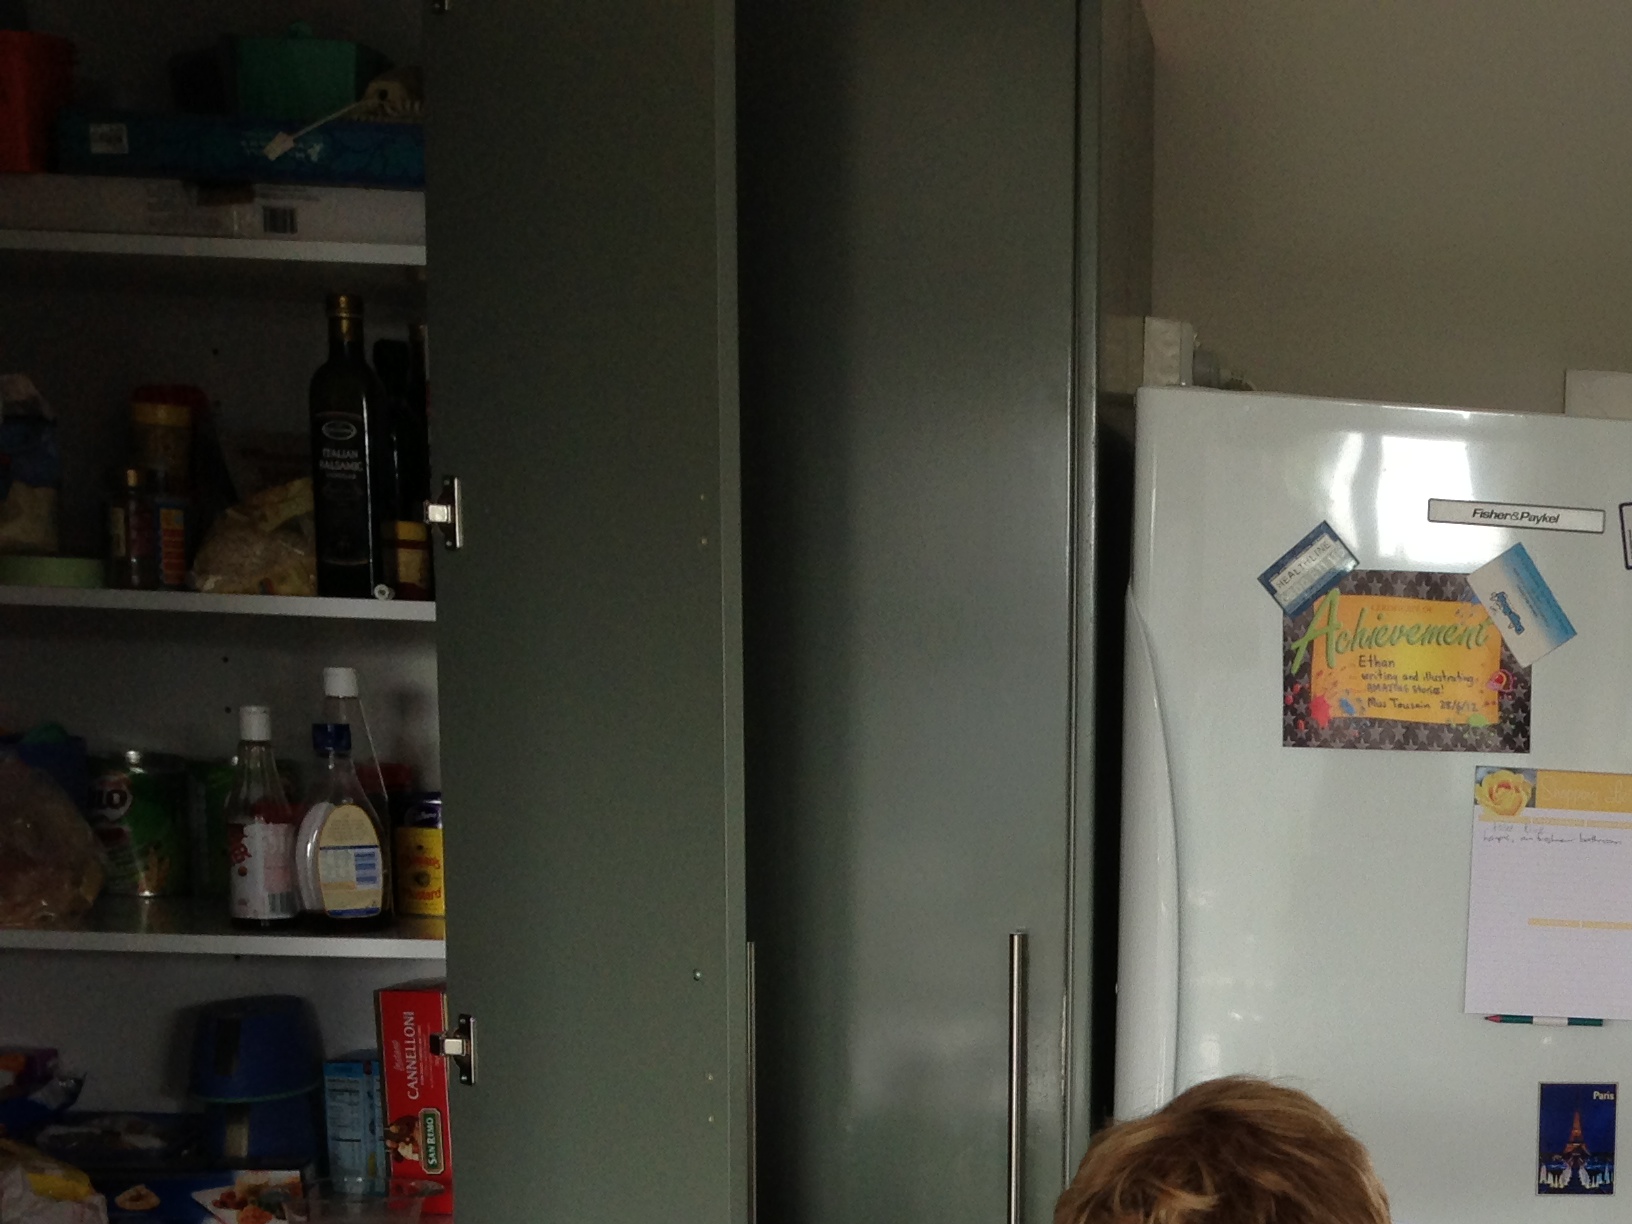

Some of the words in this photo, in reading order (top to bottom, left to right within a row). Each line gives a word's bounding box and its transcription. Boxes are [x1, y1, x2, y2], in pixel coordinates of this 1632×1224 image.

[1275, 540, 1332, 588] HEALTHLINE
[1290, 587, 1494, 675] Achievement
[1358, 654, 1395, 668] Ethan
[1361, 671, 1398, 684] writing
[1403, 671, 1419, 682] and
[403, 1011, 419, 1100] CANNELLONI
[1592, 1090, 1615, 1100] Paris
[426, 1117, 436, 1144] REMO
[428, 1145, 438, 1165] SAN
